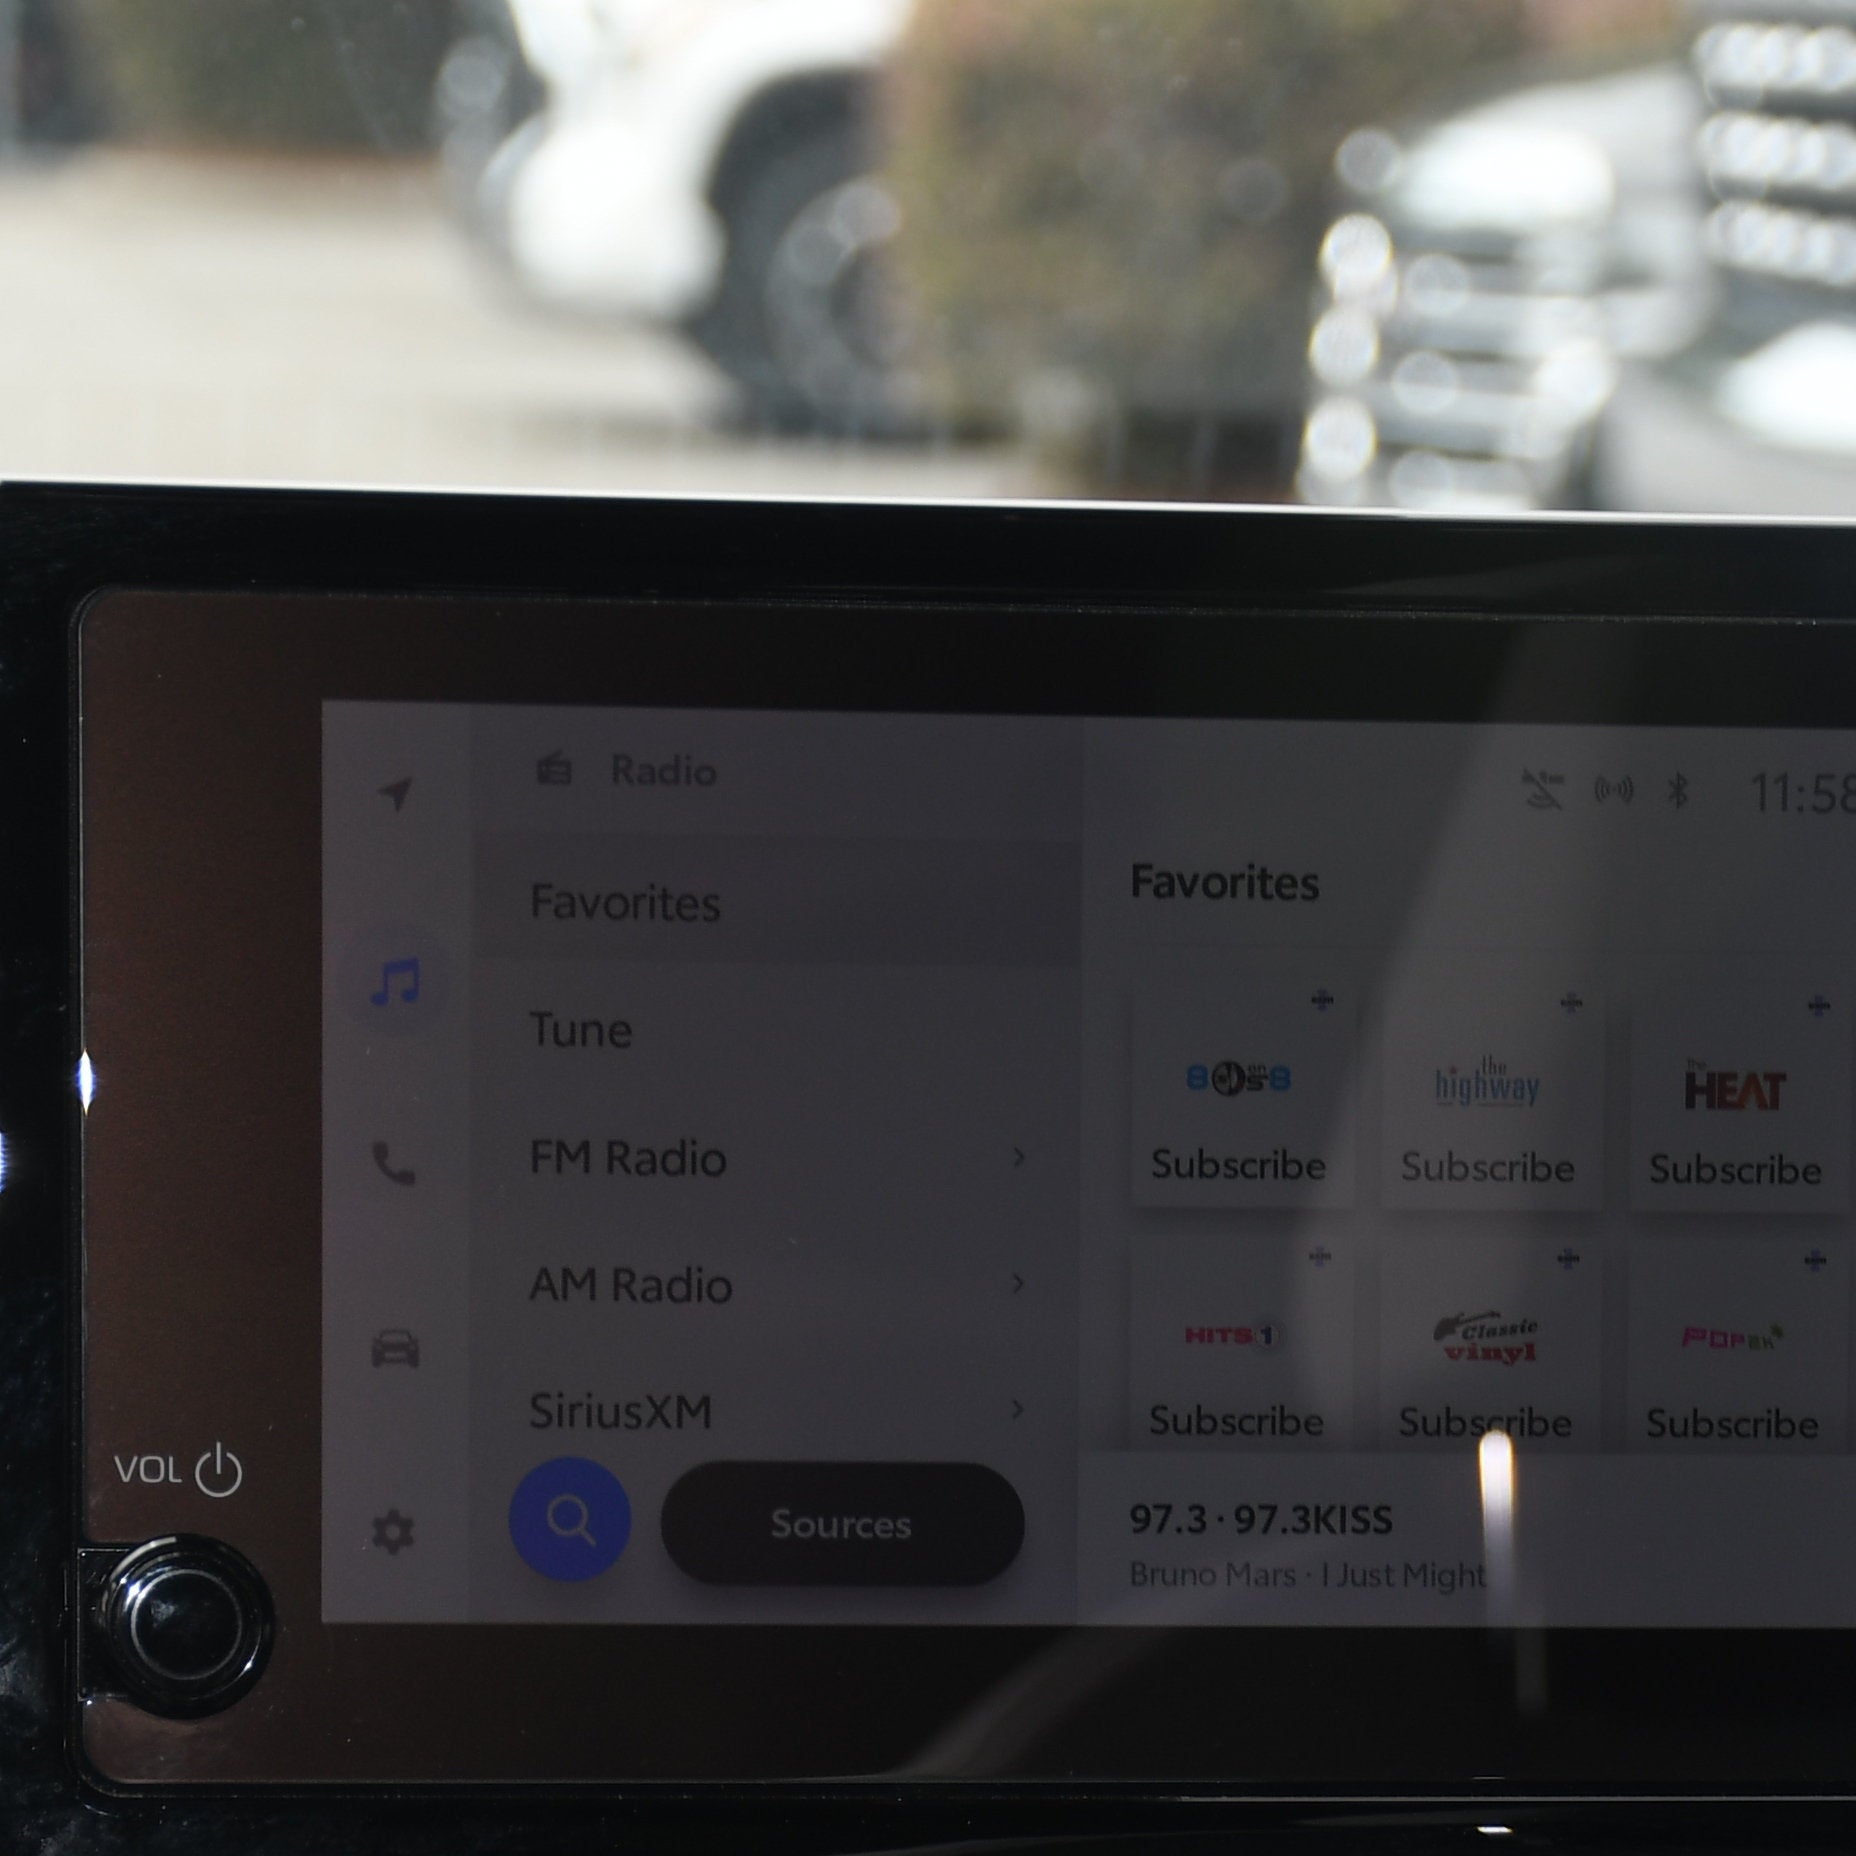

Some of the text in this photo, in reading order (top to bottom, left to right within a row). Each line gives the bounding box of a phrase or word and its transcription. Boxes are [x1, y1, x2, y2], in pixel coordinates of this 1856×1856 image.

[612, 754, 717, 787] Radio
[1132, 863, 1319, 901] Favorites
[532, 883, 721, 923] Favorites
[530, 1012, 632, 1049] Tune
[1436, 1068, 1541, 1107] highway
[1684, 1072, 1788, 1111] HEAT
[532, 1139, 727, 1177] FM Radio
[1153, 1148, 1325, 1180] Subscribe
[1403, 1150, 1577, 1186] Subscribe
[1651, 1153, 1822, 1185] Subscribe
[529, 1266, 733, 1304] AM Radio
[1185, 1327, 1253, 1344] HITS
[1462, 1318, 1538, 1340] Classic
[1444, 1343, 1536, 1366] vinyl
[531, 1392, 711, 1430] SiriusXM
[1150, 1404, 1323, 1436] Subscribe
[1398, 1404, 1574, 1442] Subscribe
[1647, 1408, 1818, 1439] Subscribe
[114, 1455, 182, 1483] VOL
[770, 1505, 914, 1544] Sources
[1130, 1504, 1206, 1534] 97.3
[1234, 1504, 1392, 1534] 97.3KISS
[1131, 1561, 1216, 1587] Bruno
[1227, 1562, 1297, 1588] Mars
[1337, 1562, 1395, 1587] Just
[1402, 1558, 1487, 1597] Might
